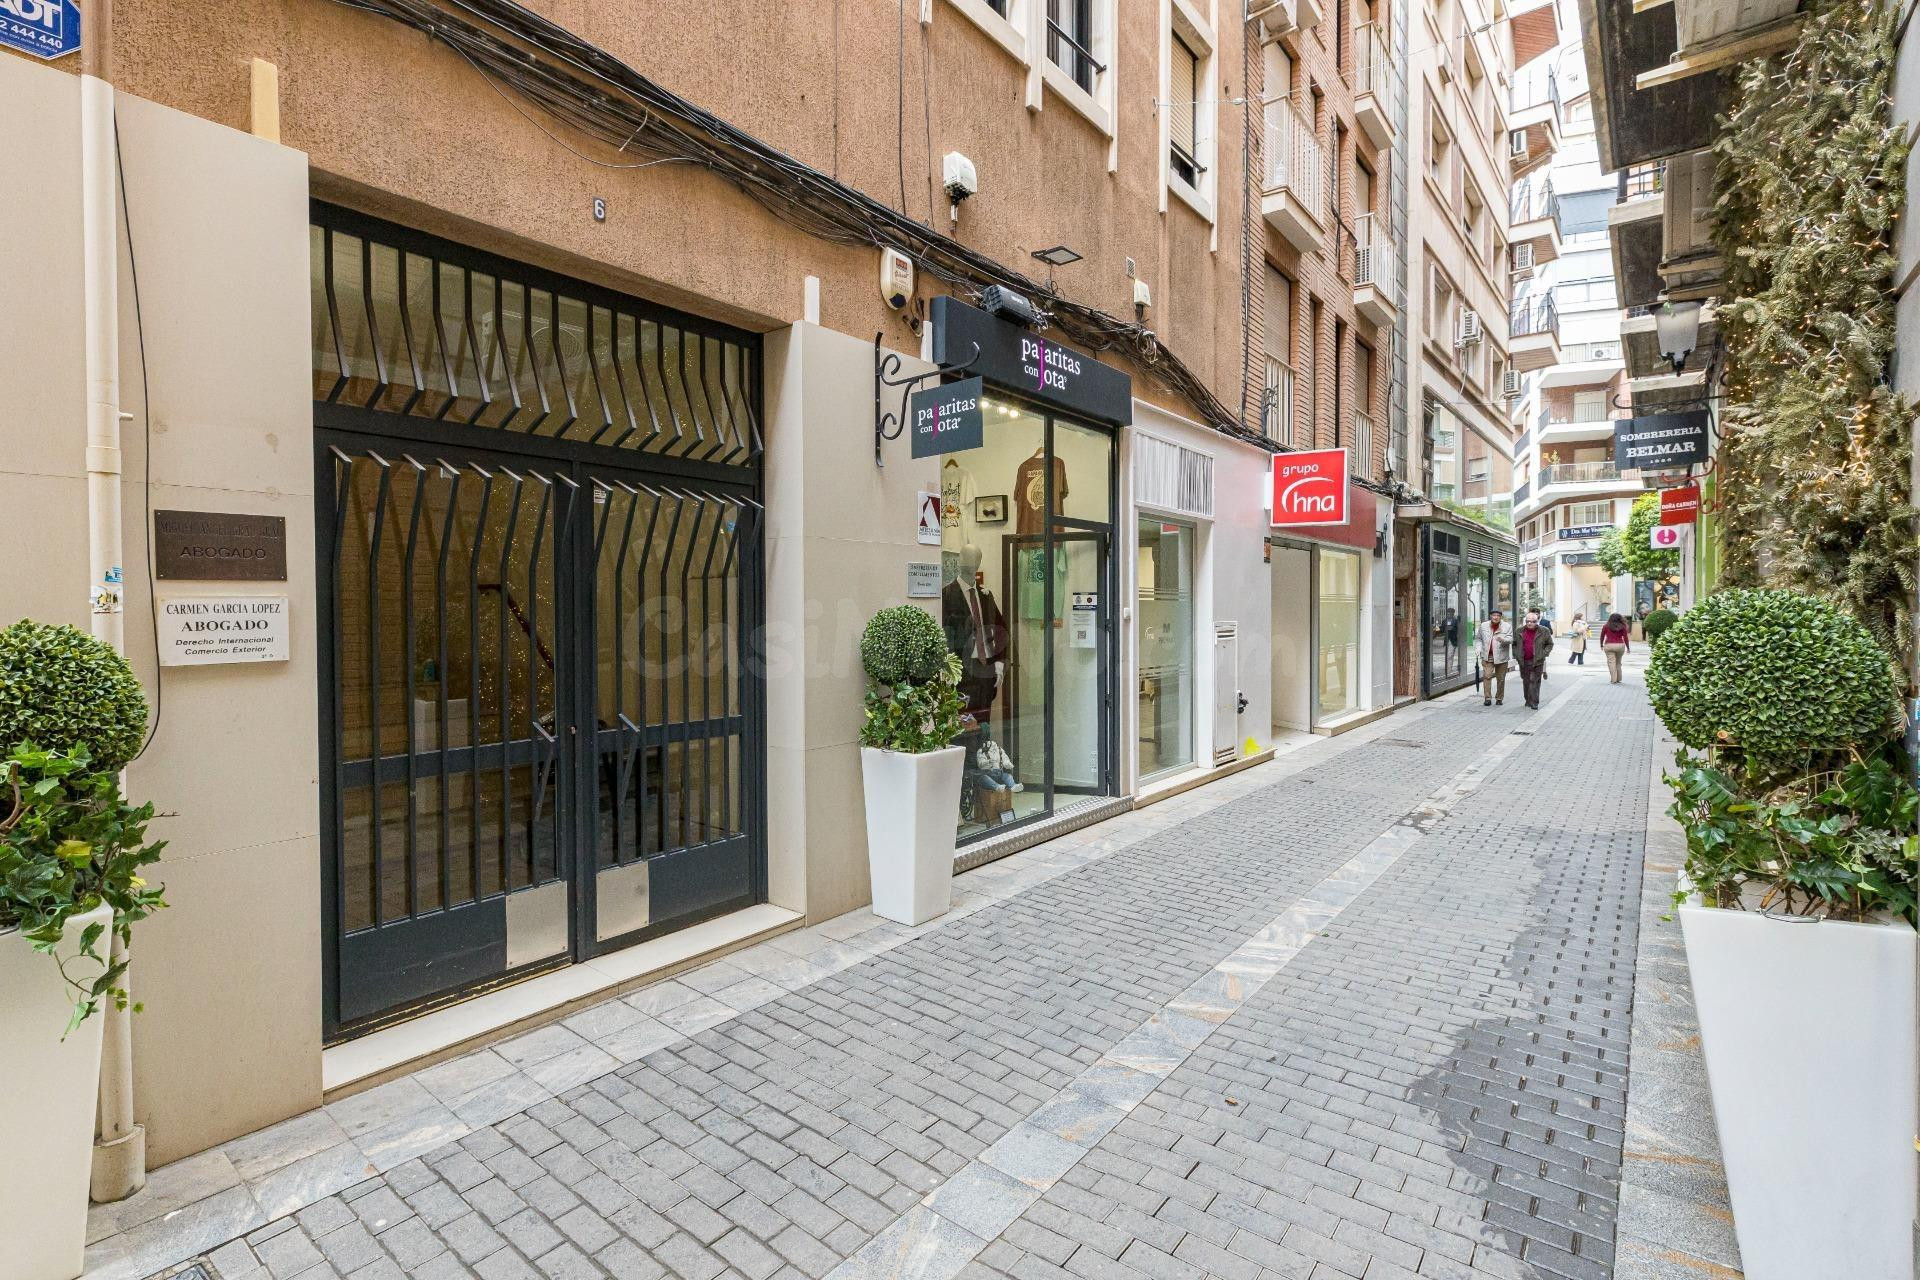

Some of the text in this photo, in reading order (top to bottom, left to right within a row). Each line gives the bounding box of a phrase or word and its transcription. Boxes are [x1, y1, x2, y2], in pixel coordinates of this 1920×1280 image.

[10, 24, 36, 40] 444
[38, 34, 63, 49] 440
[594, 199, 605, 219] 6
[1021, 338, 1081, 376] pajaritas
[1024, 364, 1039, 378] con
[917, 397, 976, 427] pajaritas
[920, 425, 933, 434] con
[1626, 441, 1696, 458] BELMAR
[1282, 464, 1319, 477] grupo
[1293, 491, 1335, 513] hna
[180, 546, 267, 560] ABOGADO
[166, 604, 209, 615] CARMEN
[181, 620, 269, 632] ABOGADO
[218, 637, 274, 645] Internacional
[185, 646, 267, 656] Comercio Exterior
